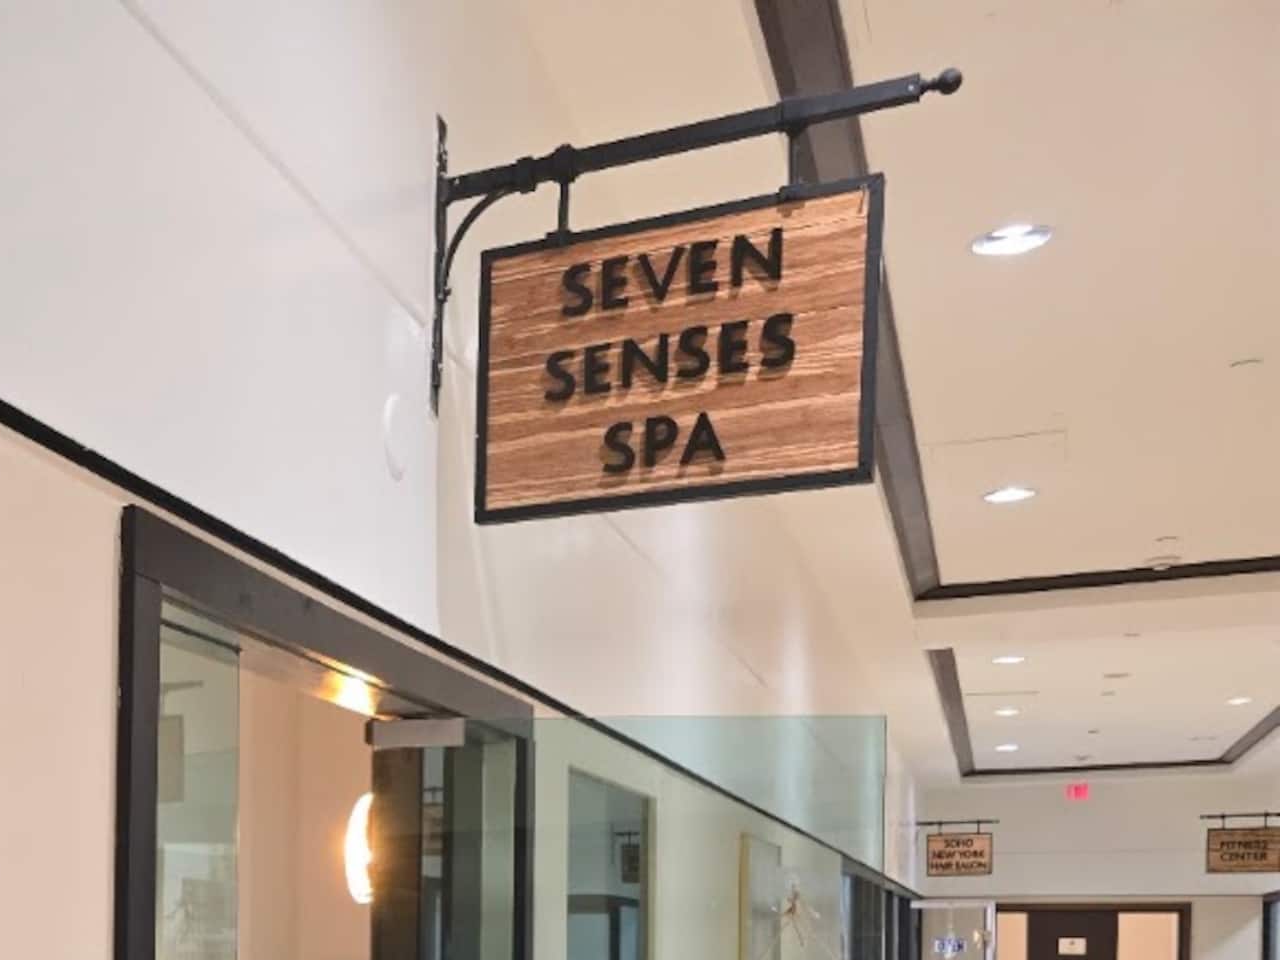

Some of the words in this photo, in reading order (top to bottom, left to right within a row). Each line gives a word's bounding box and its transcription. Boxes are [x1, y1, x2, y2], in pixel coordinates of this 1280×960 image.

[561, 227, 784, 318] SEVEN
[544, 313, 796, 401] SENSES
[603, 411, 726, 474] SPA
[944, 838, 974, 848] SOHO
[1220, 840, 1268, 849] FITNESS
[932, 850, 956, 859] NEW
[959, 849, 985, 859] YORK
[1220, 852, 1267, 861] CENTER
[930, 862, 953, 871] HAIR
[955, 861, 987, 871] SALON
